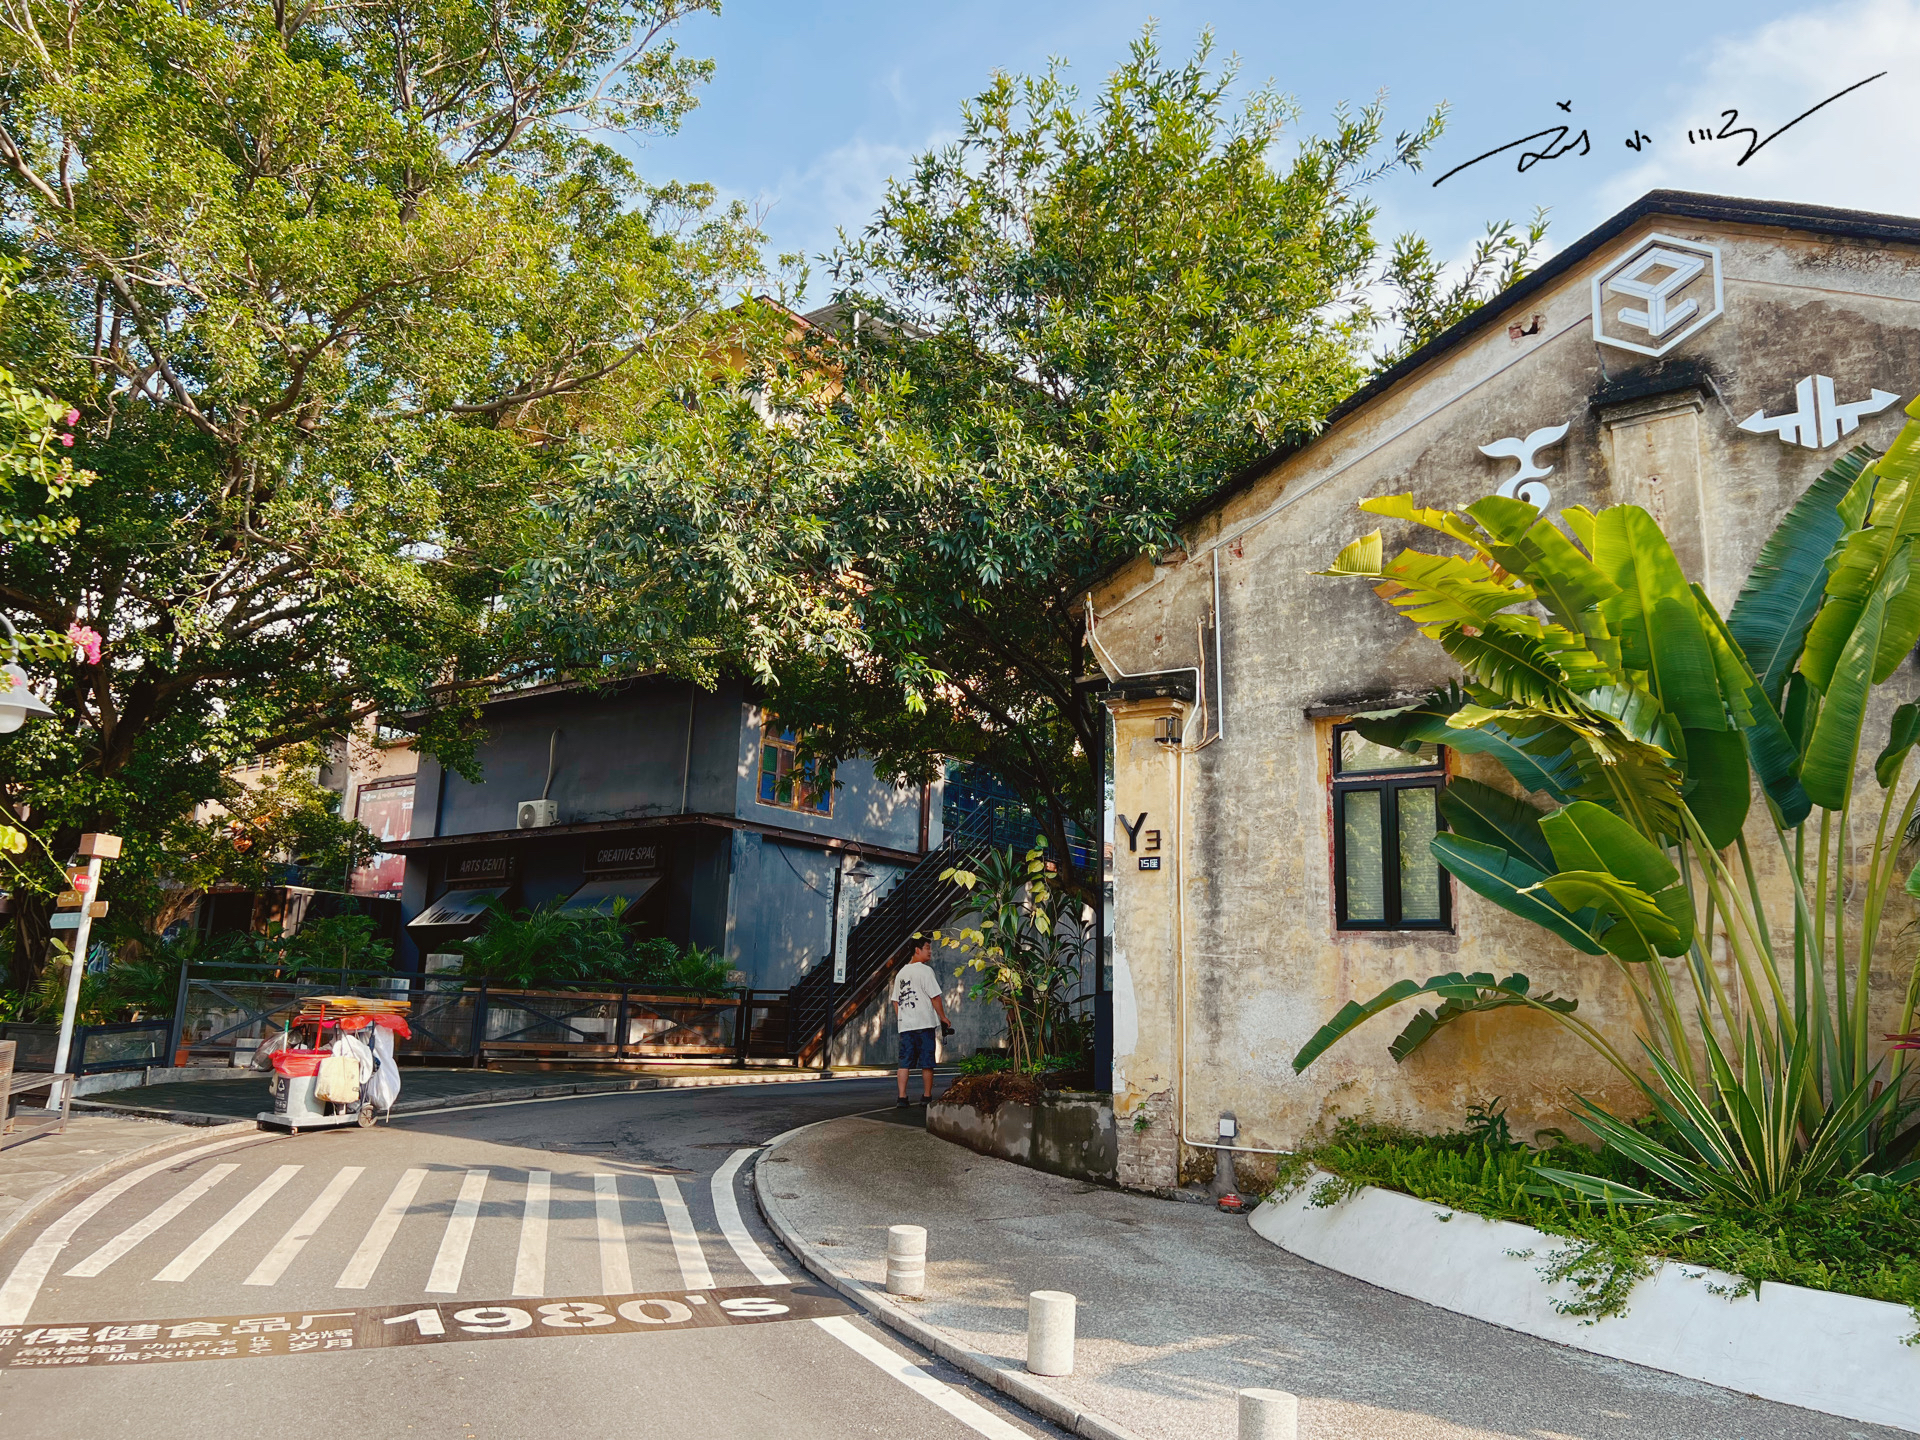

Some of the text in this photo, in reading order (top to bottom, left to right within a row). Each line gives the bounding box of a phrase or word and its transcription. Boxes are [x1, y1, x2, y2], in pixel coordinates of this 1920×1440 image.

[597, 845, 656, 863] CREATIVE SPAC
[460, 859, 480, 873] ARTS
[383, 1295, 790, 1336] 1980's
[22, 1312, 356, 1345] 保健食品厂
[288, 1338, 354, 1352] 岁月
[106, 1346, 238, 1363] 振兴中华
